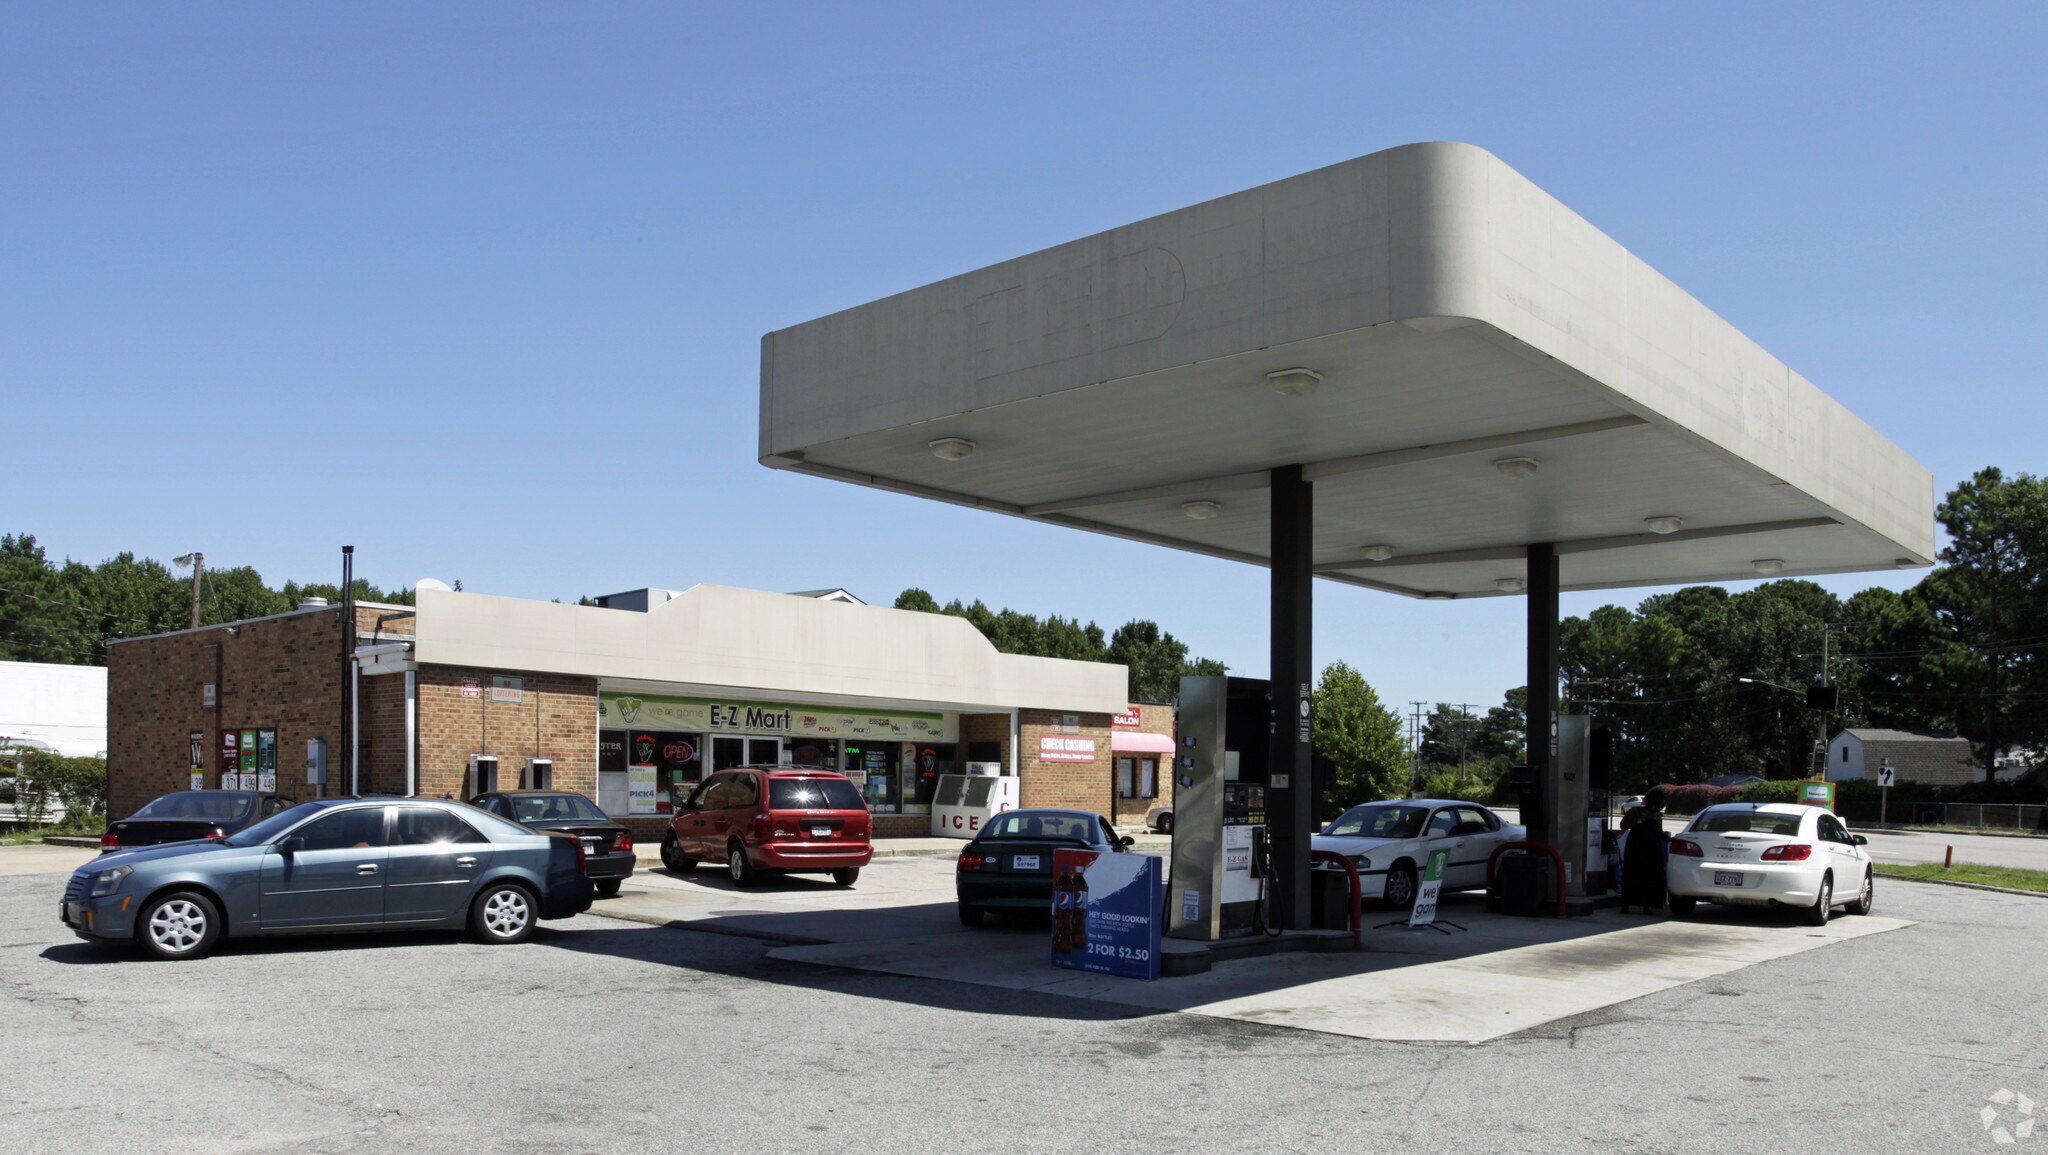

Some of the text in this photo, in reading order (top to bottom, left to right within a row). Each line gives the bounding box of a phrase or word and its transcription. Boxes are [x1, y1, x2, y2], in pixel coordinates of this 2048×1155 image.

[494, 689, 520, 699] LOITERING
[676, 707, 704, 719] game
[710, 704, 738, 726] E-Z
[746, 707, 791, 729] Mart
[1113, 716, 1139, 725] SALON
[1041, 737, 1095, 752] CHECK CASHING
[664, 745, 689, 759] OPEN
[226, 777, 236, 789] 371
[244, 778, 255, 789] 499
[263, 778, 274, 791] 449
[942, 814, 979, 831] ICE
[1088, 911, 1150, 924] HEY GOOD LOOKIN'
[1087, 943, 1149, 961] 2 FOR $2.50
